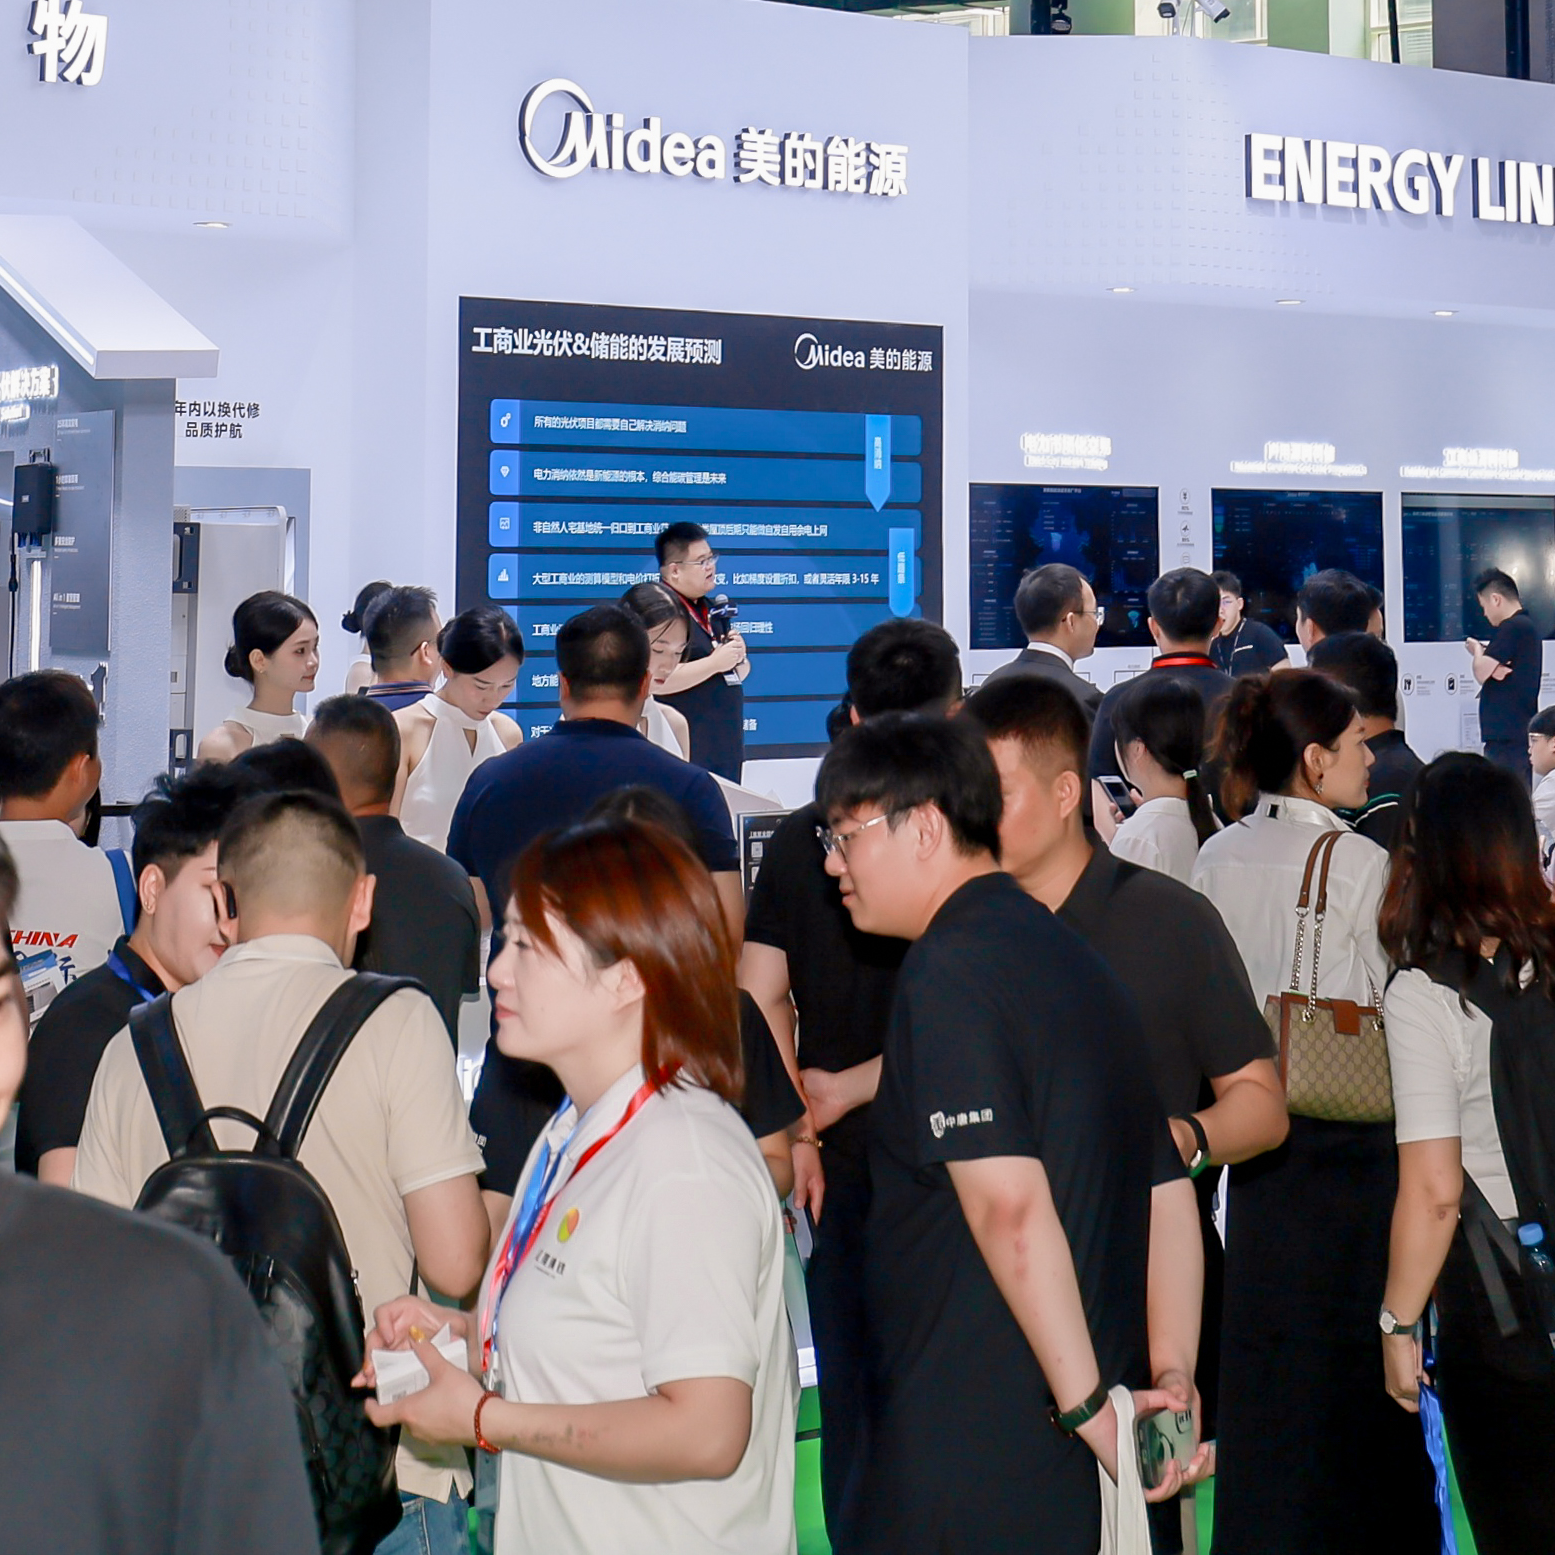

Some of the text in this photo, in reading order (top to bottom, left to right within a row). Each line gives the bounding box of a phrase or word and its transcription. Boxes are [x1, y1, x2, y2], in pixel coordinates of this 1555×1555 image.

[518, 77, 909, 198] Midea 美的能源
[1245, 131, 1465, 217] ENERGY
[471, 326, 723, 365] 工商业光伏&储能的发展预测
[794, 332, 933, 373] Midea 美的能源
[174, 400, 260, 419] 年内以换代修
[185, 421, 243, 438] 品质护航
